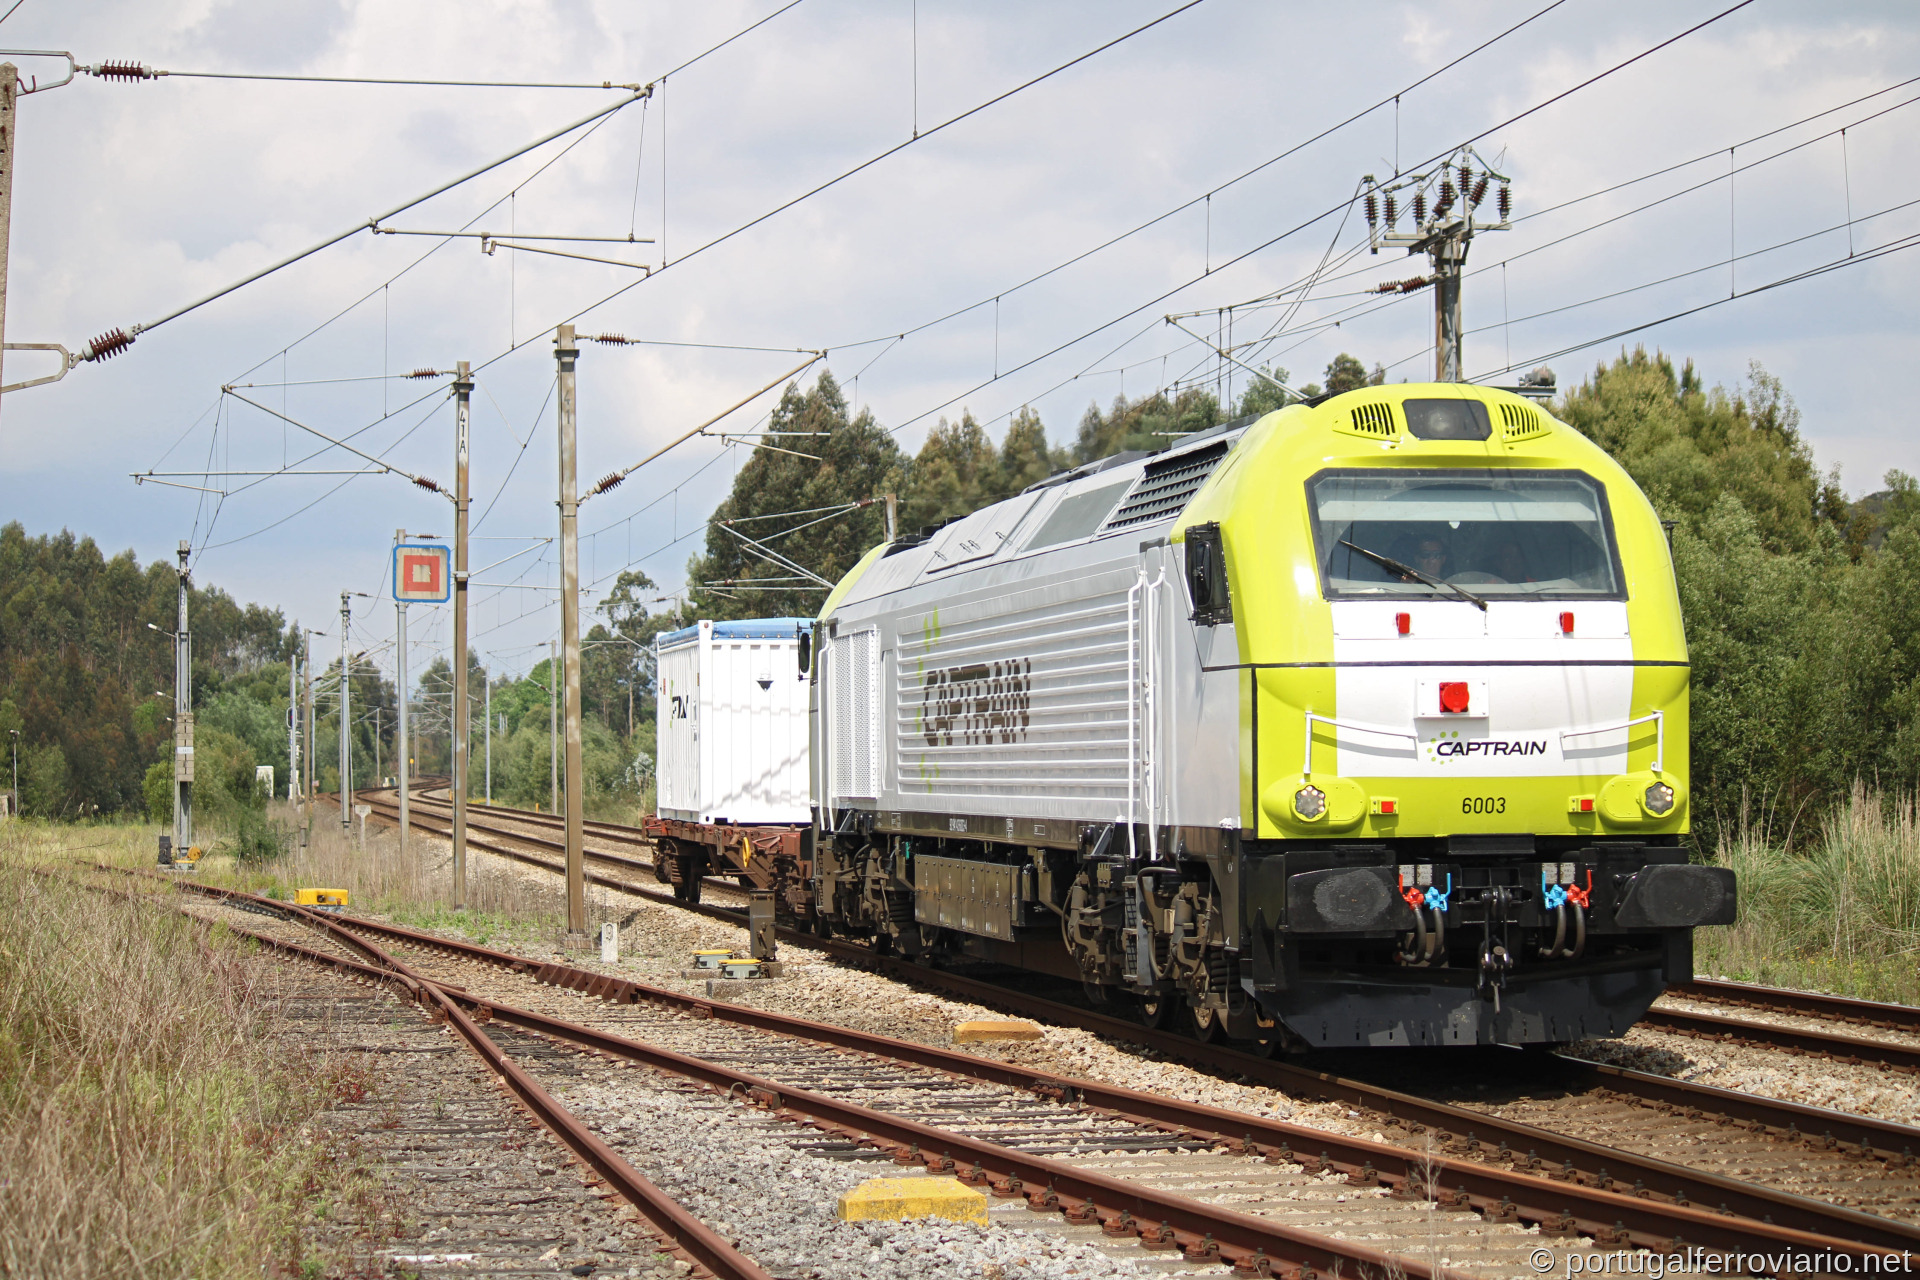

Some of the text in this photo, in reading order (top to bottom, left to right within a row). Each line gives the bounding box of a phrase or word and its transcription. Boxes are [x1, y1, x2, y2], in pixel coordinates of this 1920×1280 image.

[563, 389, 571, 425] 41
[459, 410, 467, 454] 41A
[924, 657, 1031, 746] CAPTRAIN
[1437, 741, 1547, 756] CAPTRAIN
[1462, 797, 1506, 814] 6003
